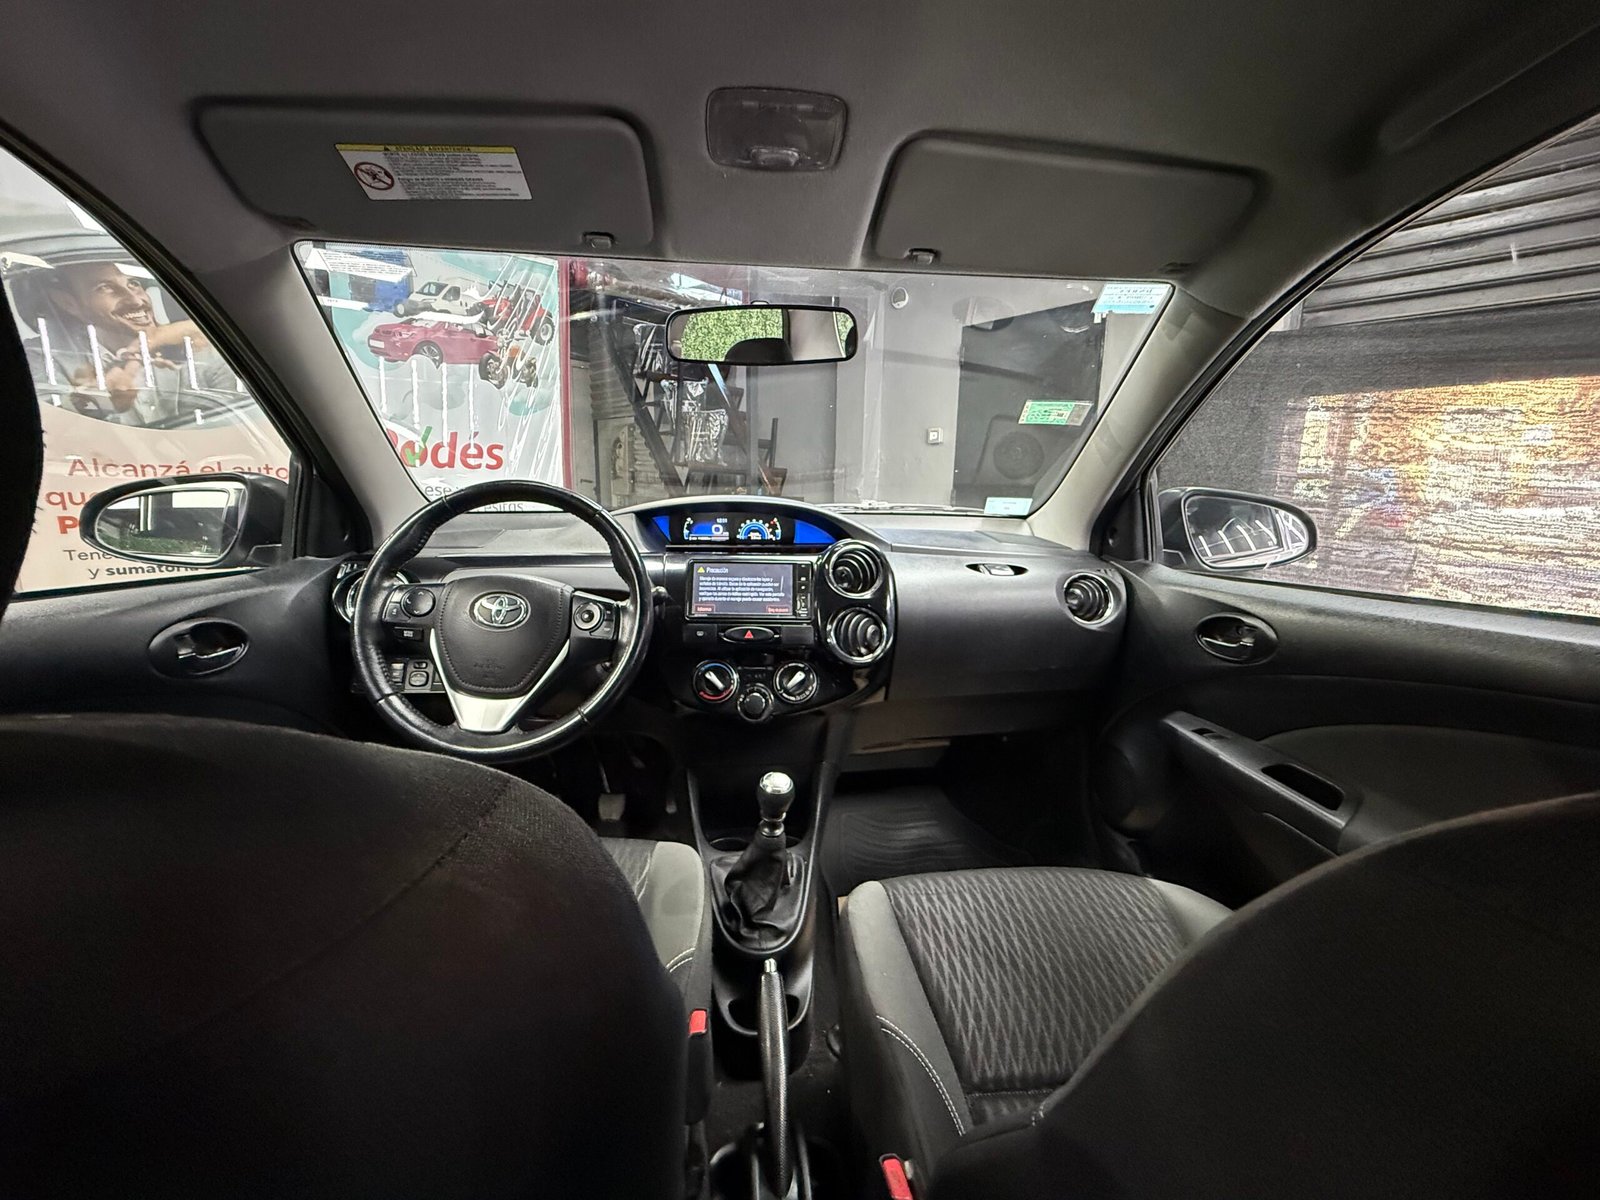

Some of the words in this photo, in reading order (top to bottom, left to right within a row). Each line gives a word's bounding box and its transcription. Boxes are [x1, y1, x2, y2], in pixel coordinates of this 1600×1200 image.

[67, 458, 190, 478] Alcanzá
[45, 491, 98, 511] qu
[88, 568, 100, 580] y
